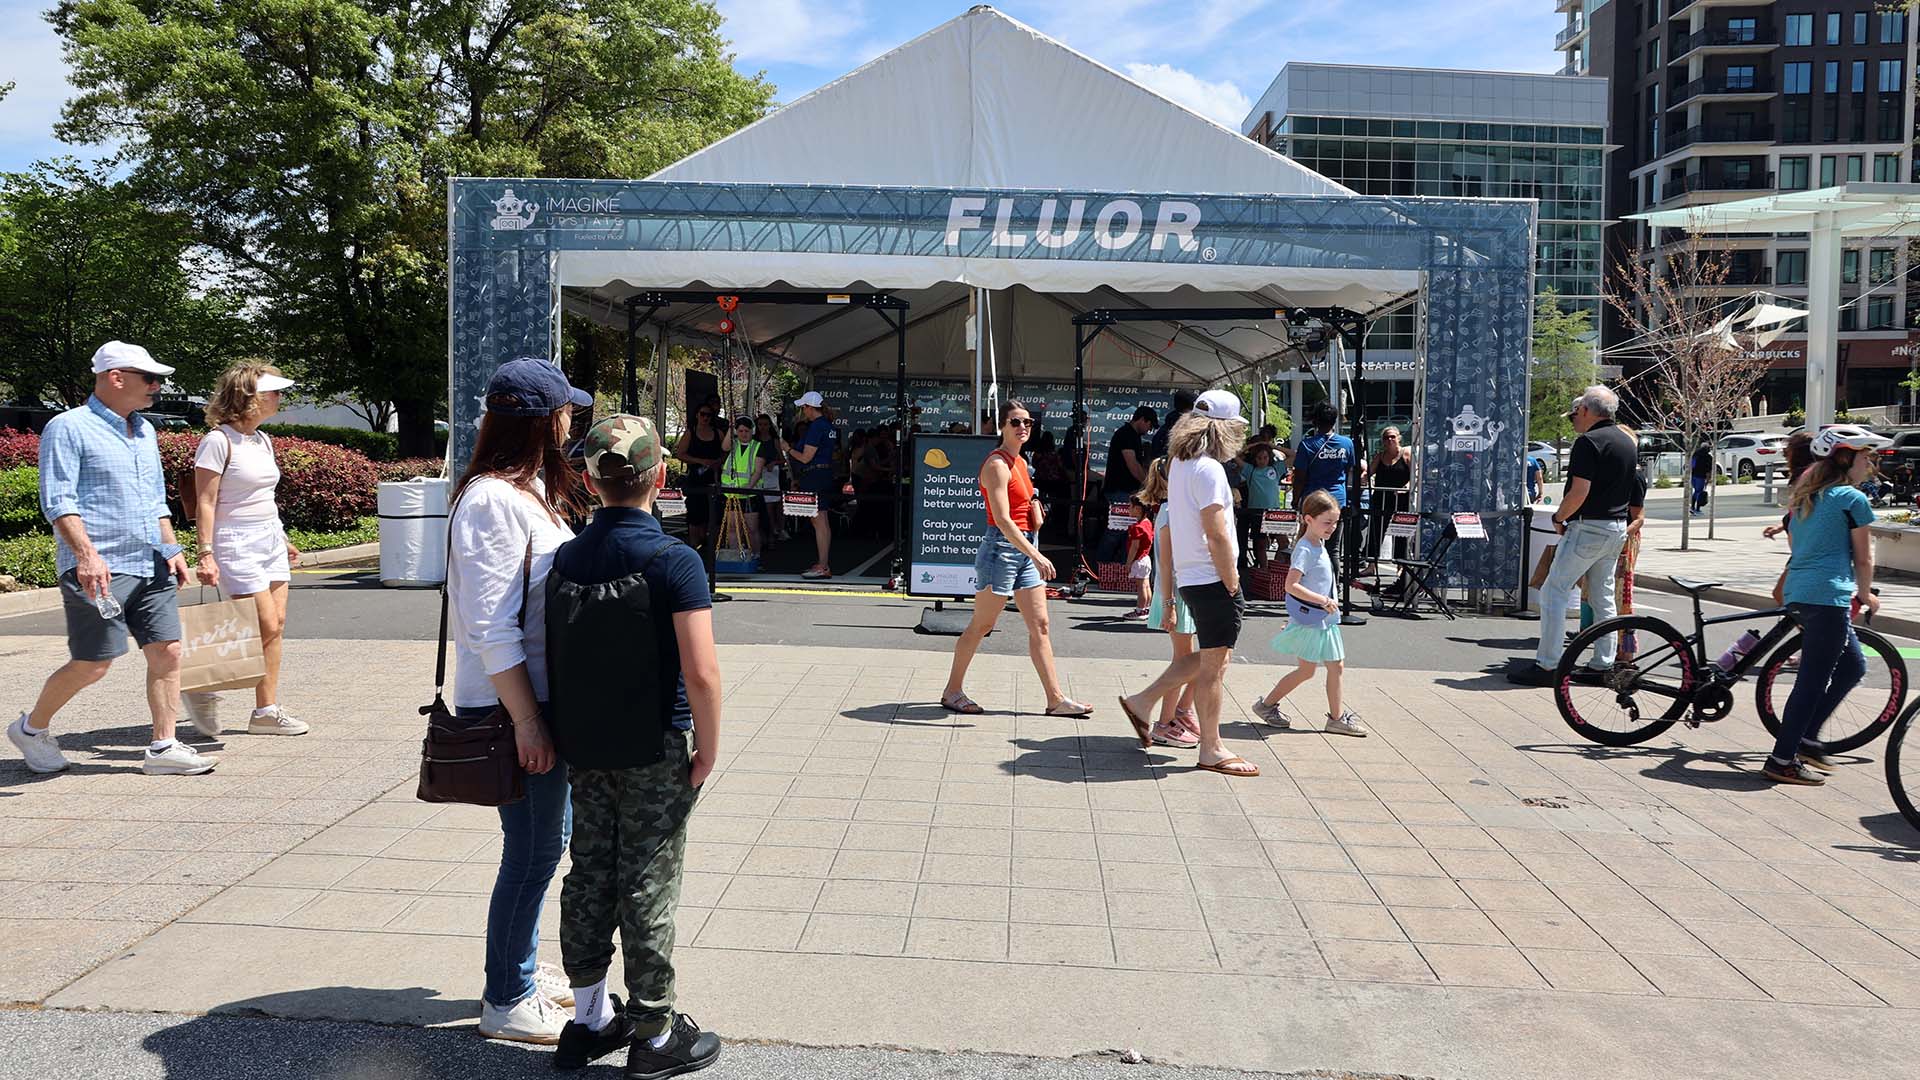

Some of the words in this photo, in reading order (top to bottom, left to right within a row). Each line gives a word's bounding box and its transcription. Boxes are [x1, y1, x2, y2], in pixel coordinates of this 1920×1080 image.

[546, 216, 625, 226] UPSTATE
[1108, 386, 1138, 394] FLUOR
[941, 393, 971, 401] FLUOR
[849, 405, 879, 413] FLUOR
[924, 474, 946, 484] Join
[949, 475, 975, 484] Fluor
[923, 487, 946, 498] help
[948, 488, 972, 497] build
[923, 499, 955, 508] better
[922, 519, 948, 529] Grab
[950, 521, 973, 531] your
[922, 532, 946, 541] hard
[948, 533, 966, 542] hat
[921, 544, 940, 555] join
[942, 545, 959, 554] the
[961, 546, 979, 555] tea
